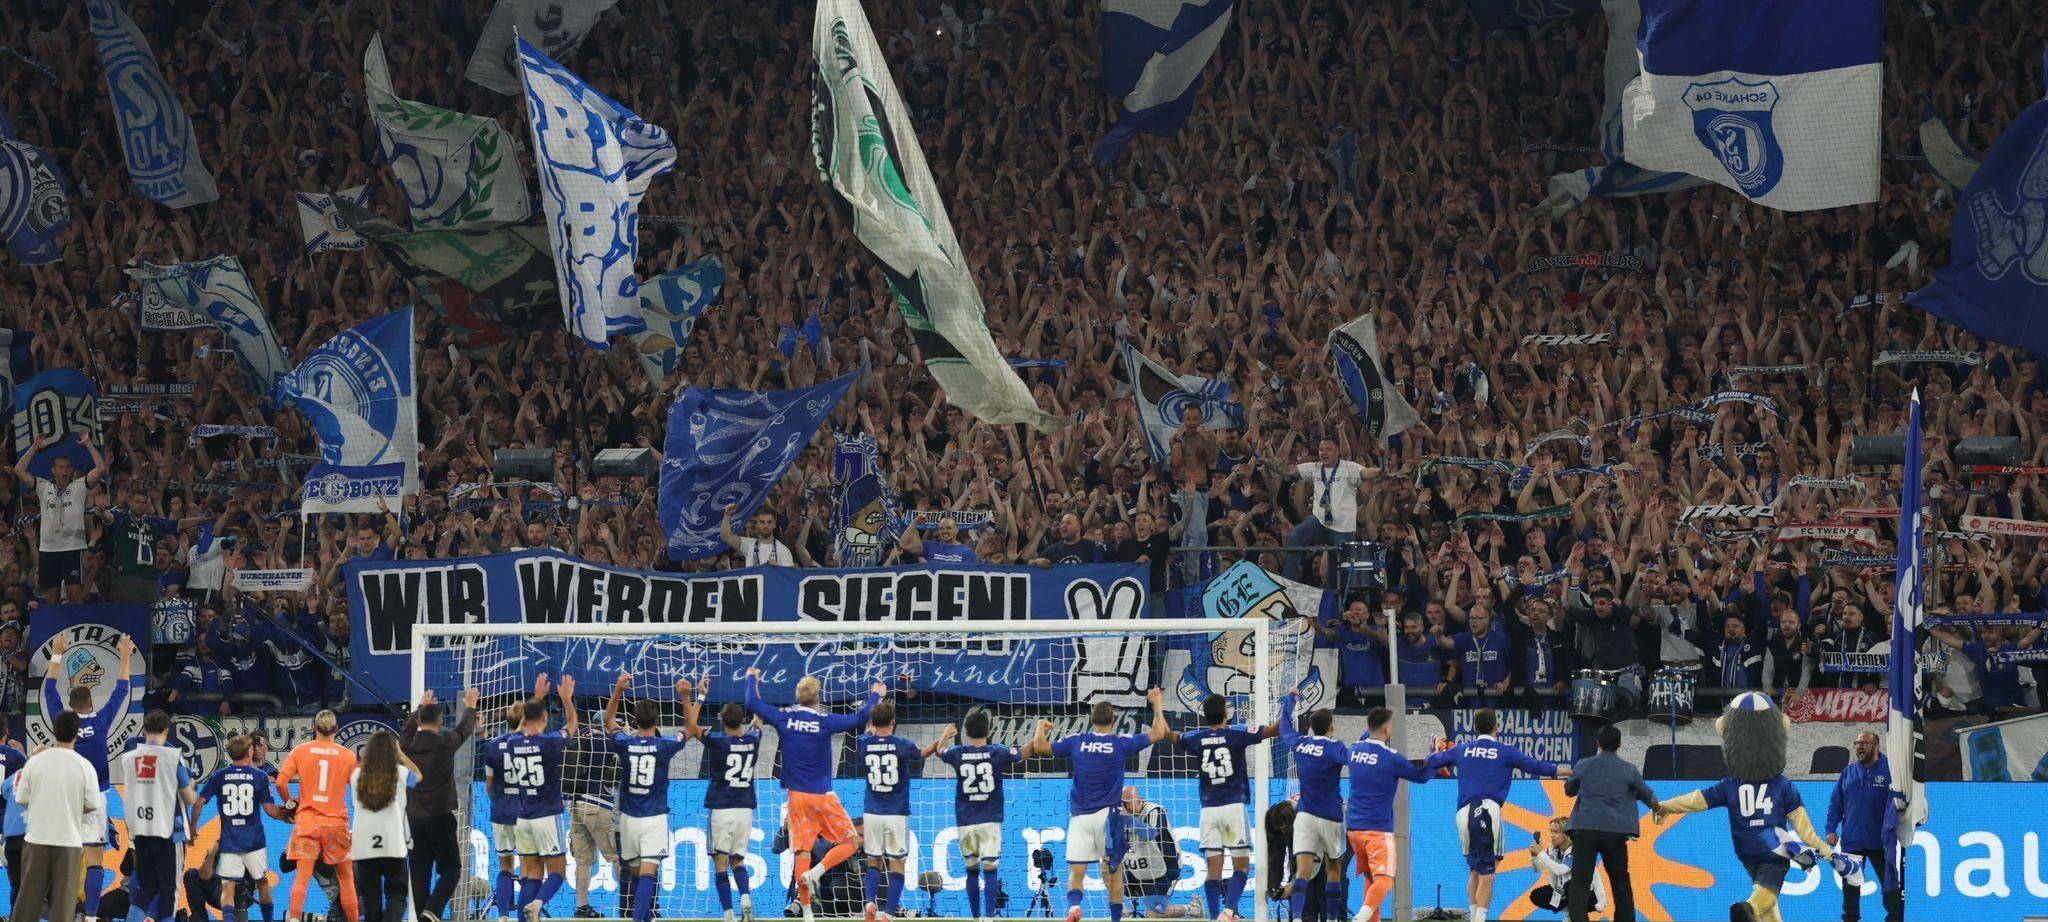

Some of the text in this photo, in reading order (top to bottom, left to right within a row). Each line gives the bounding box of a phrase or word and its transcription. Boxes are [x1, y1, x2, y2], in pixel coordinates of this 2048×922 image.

[130, 126, 169, 170] 04
[29, 388, 105, 447] 04
[350, 480, 399, 499] BOYZ
[911, 511, 946, 524] WRDEN
[1818, 527, 1860, 535] TWENTE
[1988, 520, 2003, 531] FC
[240, 572, 303, 581] DURCHHALTEN
[262, 580, 281, 588] TIM!
[359, 557, 1032, 657] WIR WERDEN SIEGEN!
[1216, 573, 1260, 618] GE
[1814, 689, 1889, 721] ULTRAS
[77, 725, 96, 739] RS
[787, 718, 820, 733] HRS
[1453, 708, 1574, 735] FUBALLCLUB
[1080, 741, 1114, 754] HRS
[1296, 743, 1324, 757] HRS
[1350, 750, 1379, 765] HRS
[1464, 746, 1498, 760] HRS
[319, 759, 329, 792] 1
[513, 755, 545, 788] 25
[628, 754, 657, 787] 19
[724, 752, 754, 783] 24
[864, 753, 899, 787] 33
[1201, 747, 1234, 779] 43
[960, 761, 995, 794] 23
[136, 806, 154, 821] 08
[222, 783, 254, 817] 38
[1738, 784, 1774, 818] 04
[371, 834, 384, 849] 2
